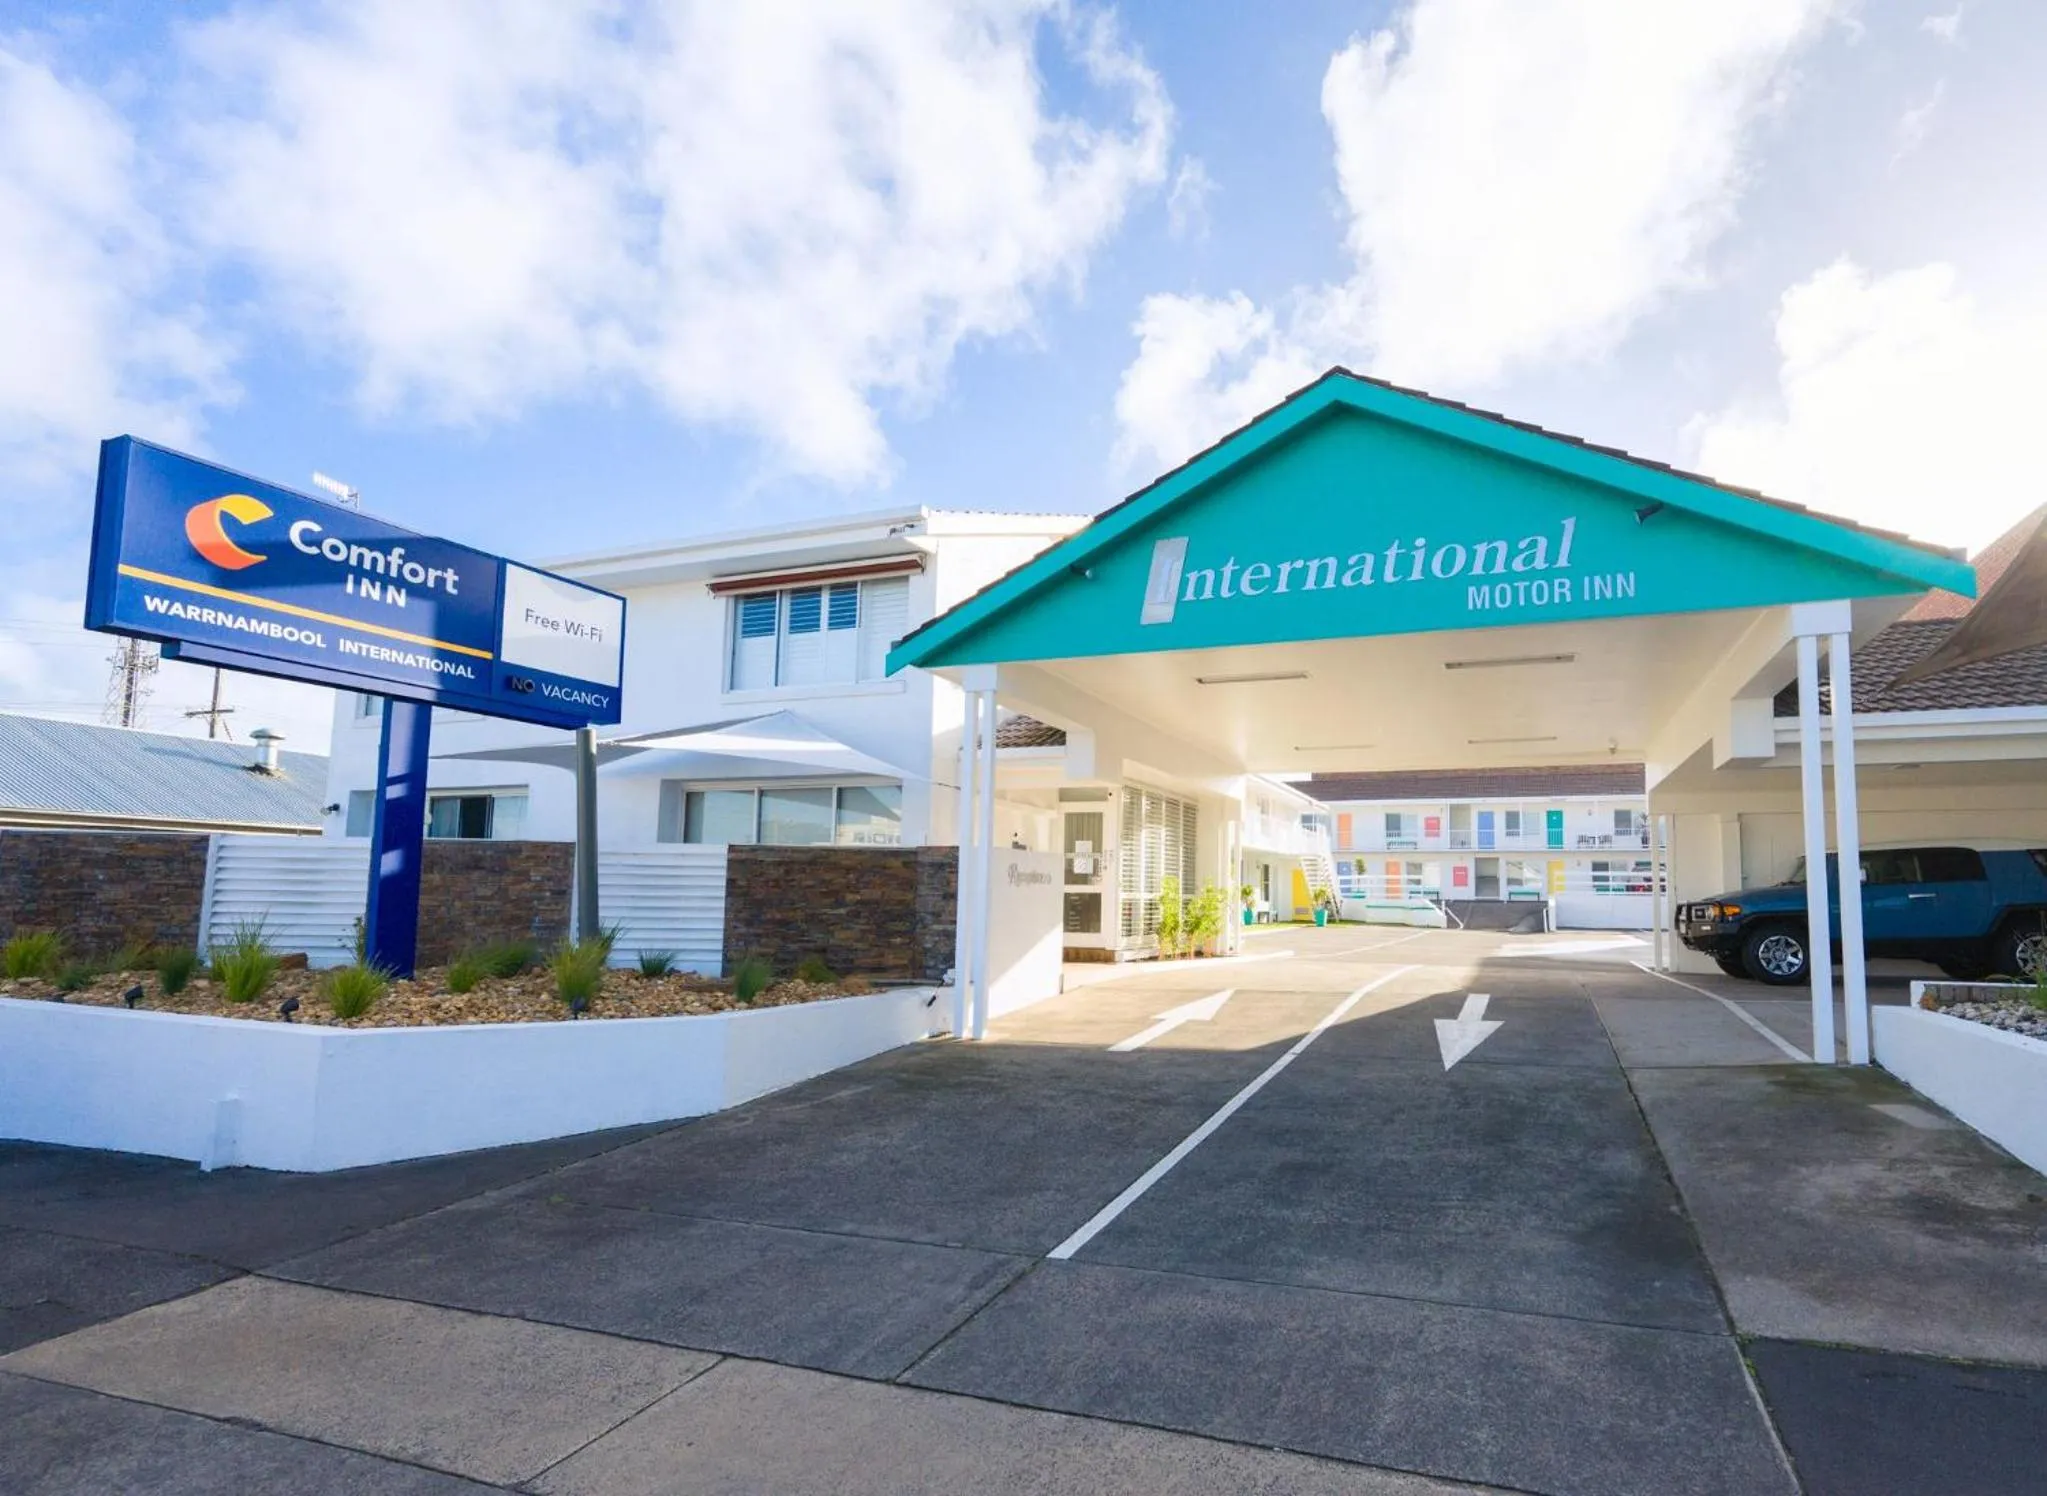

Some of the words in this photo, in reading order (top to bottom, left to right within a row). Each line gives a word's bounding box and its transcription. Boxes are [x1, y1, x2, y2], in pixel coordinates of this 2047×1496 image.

[289, 520, 459, 595] Comfort
[1140, 516, 1577, 624] International
[346, 574, 407, 608] INN
[1467, 578, 1572, 610] MOTOR
[1583, 571, 1636, 601] INN
[144, 595, 327, 648] WARRNAMBOOL
[339, 638, 476, 679] INTERNATIONAL
[524, 607, 561, 631] Free
[564, 619, 603, 642] Wi-Fi
[511, 676, 536, 693] NO
[541, 683, 610, 708] VACANCY
